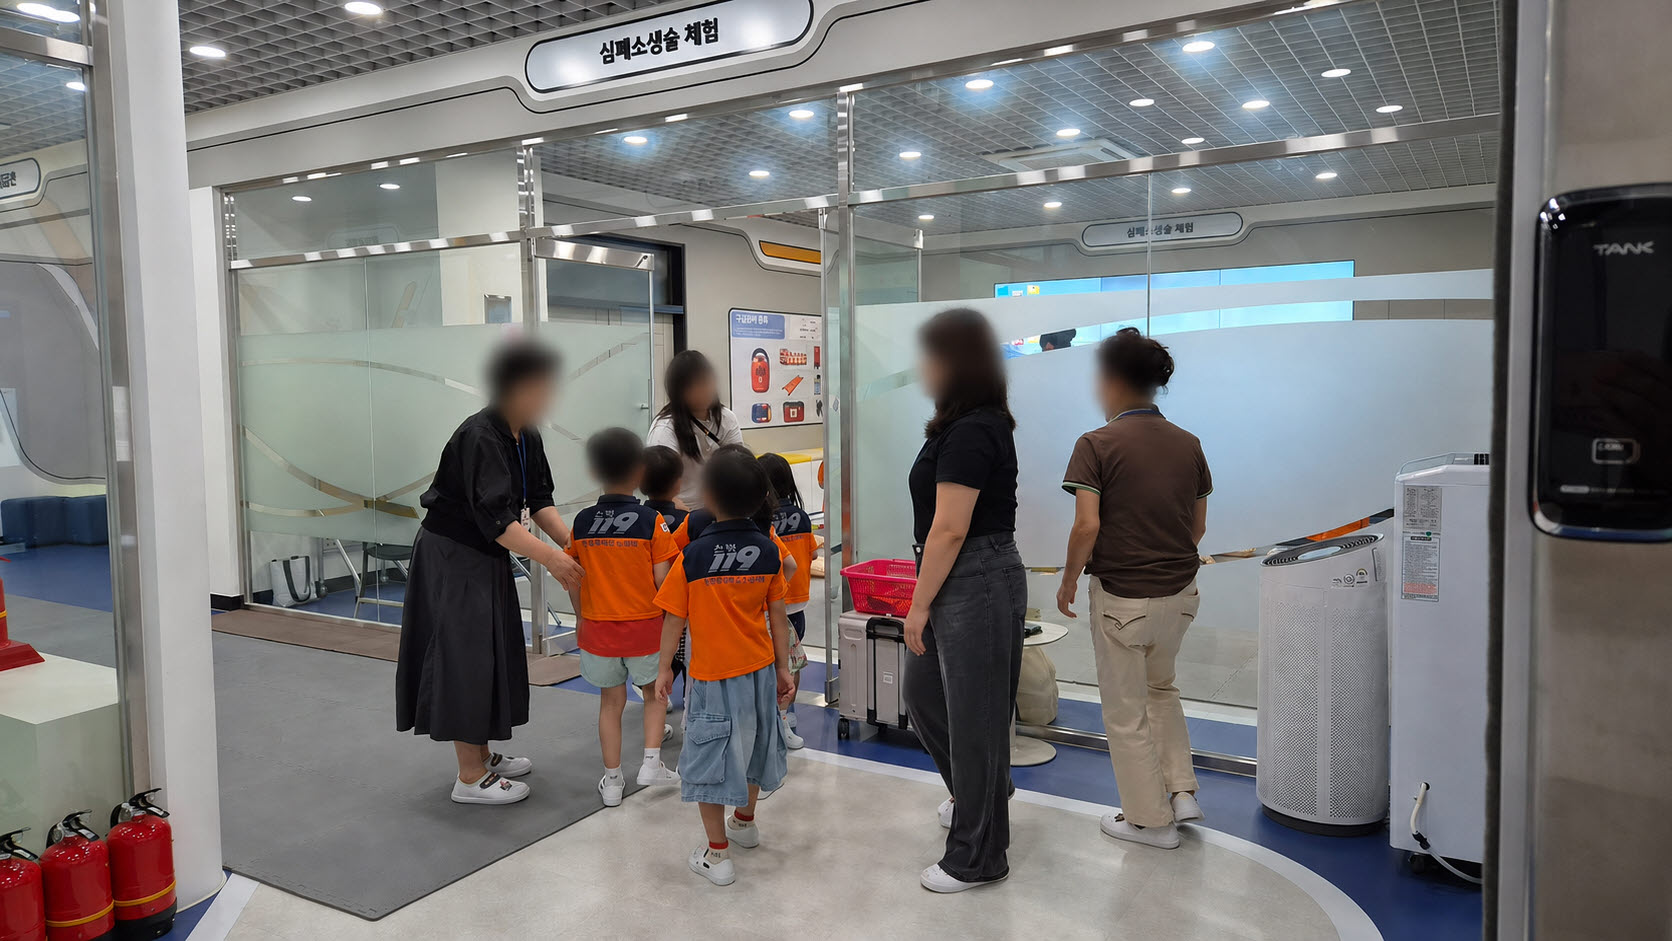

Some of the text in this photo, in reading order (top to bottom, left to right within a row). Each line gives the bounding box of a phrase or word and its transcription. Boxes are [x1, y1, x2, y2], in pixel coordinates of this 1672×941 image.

[600, 17, 719, 64] 심폐소생술 체험
[1593, 241, 1654, 256] TANK
[587, 511, 640, 535] 119
[707, 545, 761, 573] 119
